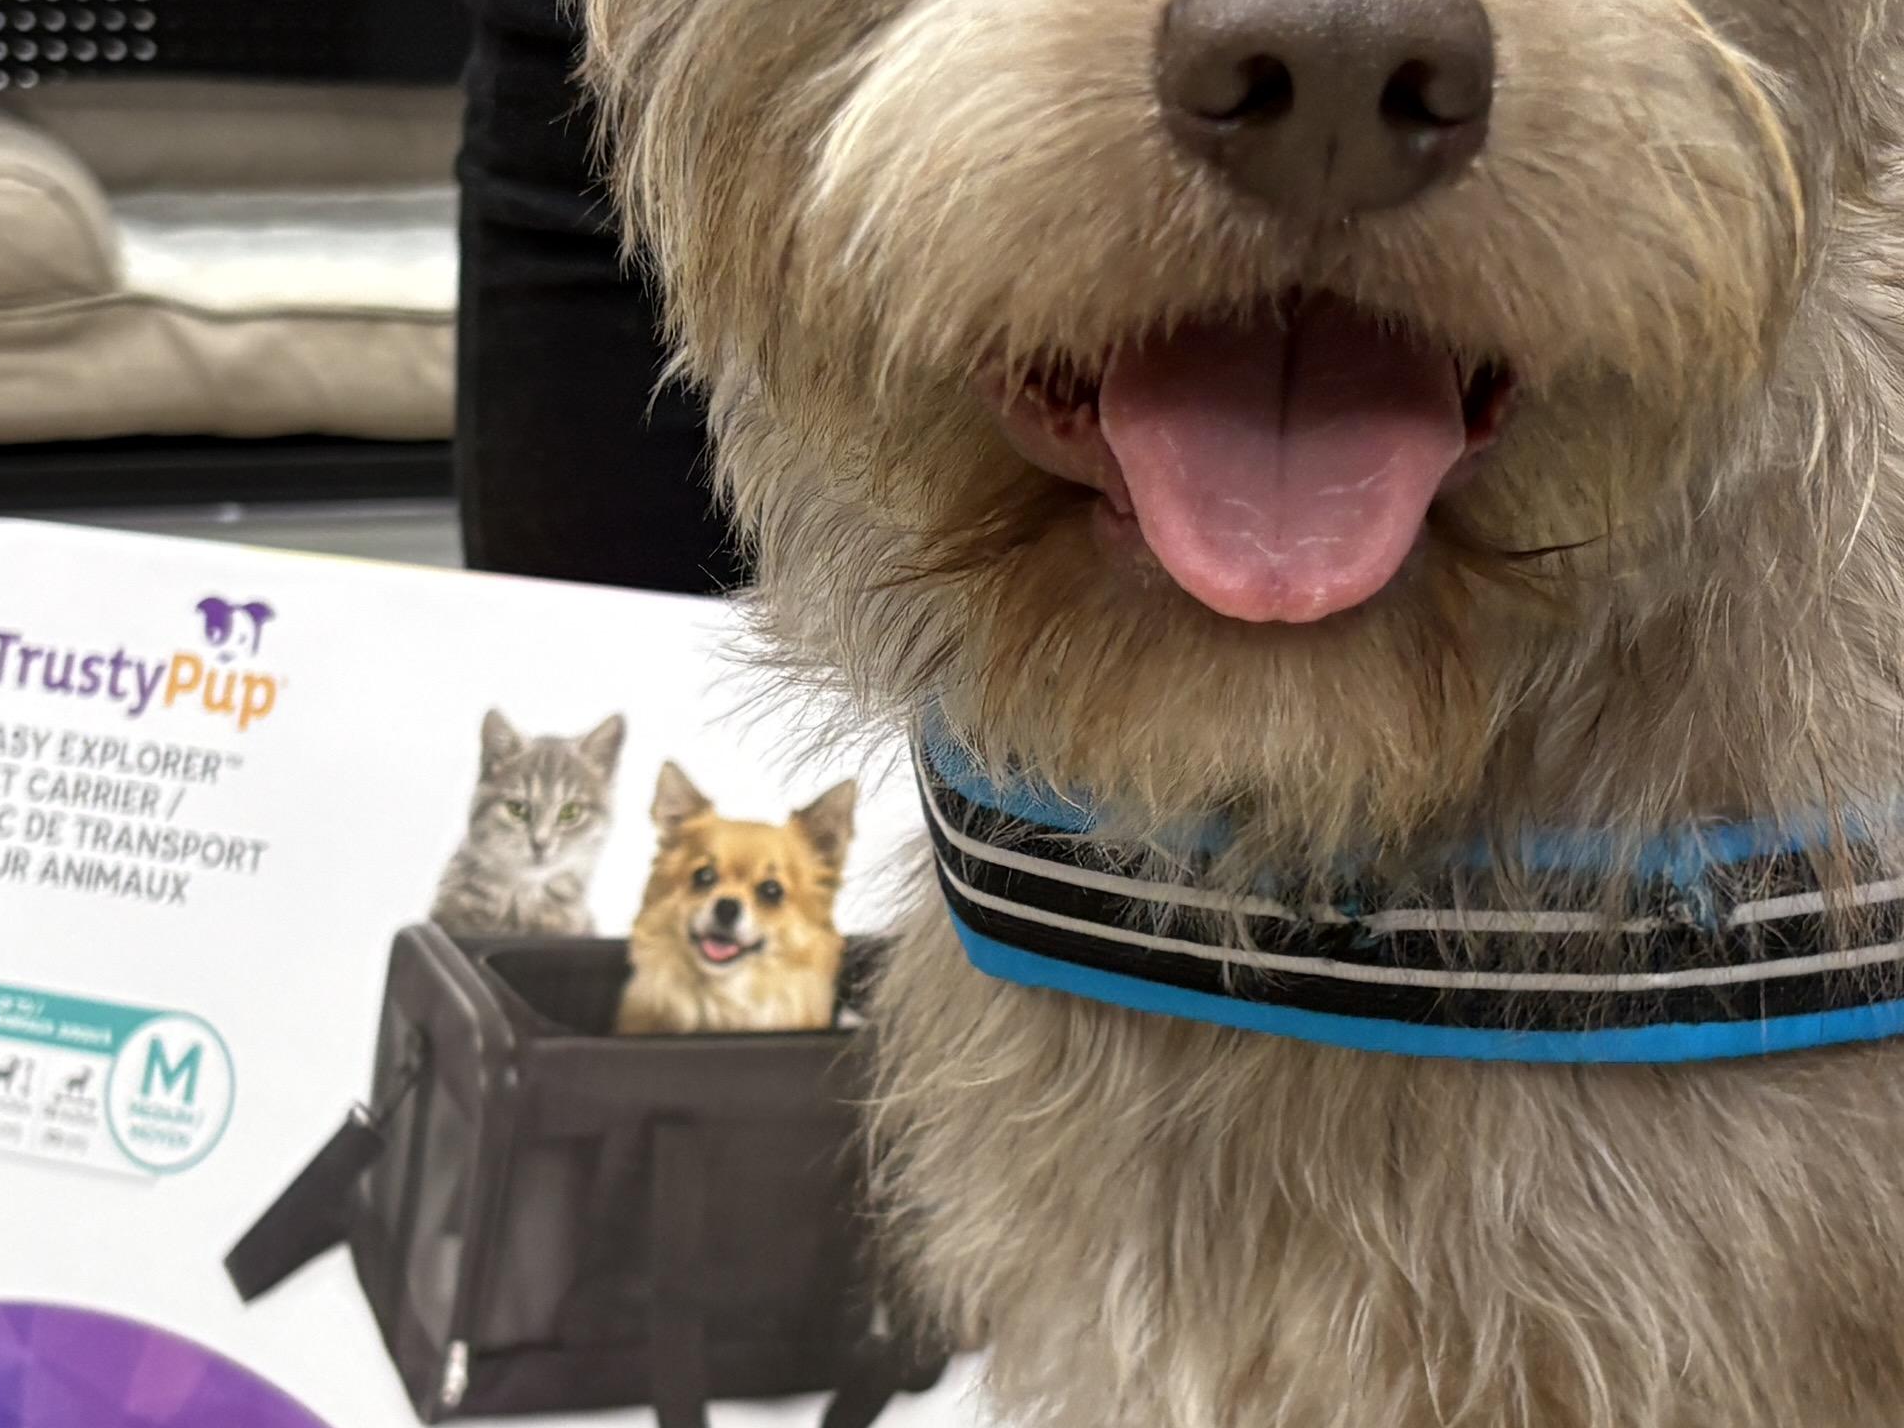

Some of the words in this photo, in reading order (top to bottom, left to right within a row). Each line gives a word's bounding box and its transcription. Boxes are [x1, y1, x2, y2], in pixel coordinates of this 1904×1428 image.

[27, 767, 163, 819] CARRIER
[23, 808, 69, 845] DE
[73, 815, 270, 874] TRANSPORT
[38, 850, 192, 906] ANIMAUX
[140, 1032, 203, 1106] M
